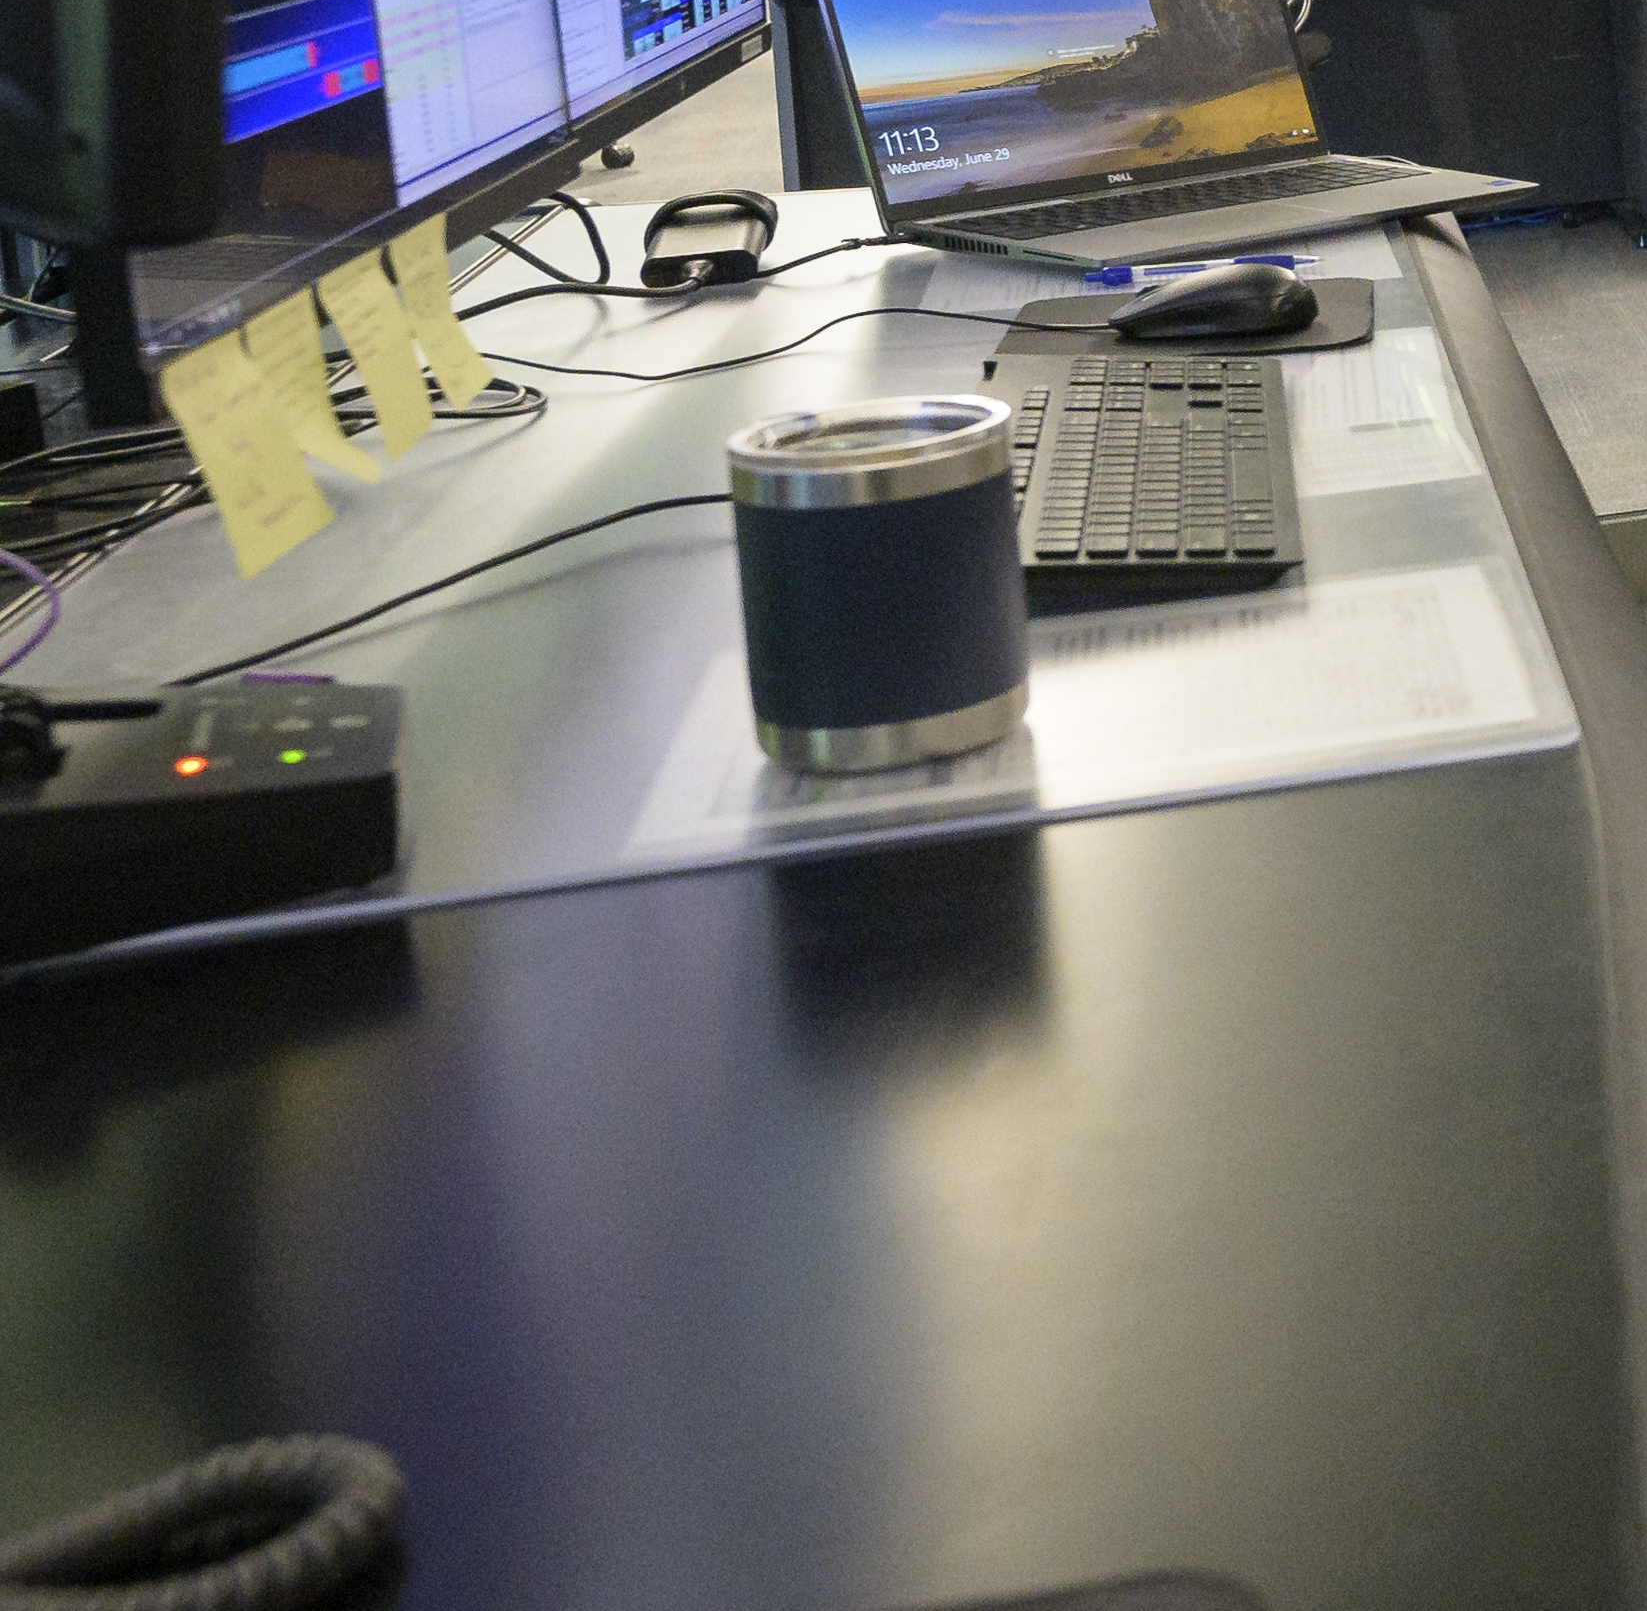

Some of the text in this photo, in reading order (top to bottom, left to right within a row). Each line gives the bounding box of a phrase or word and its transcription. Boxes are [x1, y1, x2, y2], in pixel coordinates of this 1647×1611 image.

[878, 126, 939, 157] 11:13
[886, 148, 1010, 175] Wednesday, June 29
[1107, 172, 1133, 184] DELL
